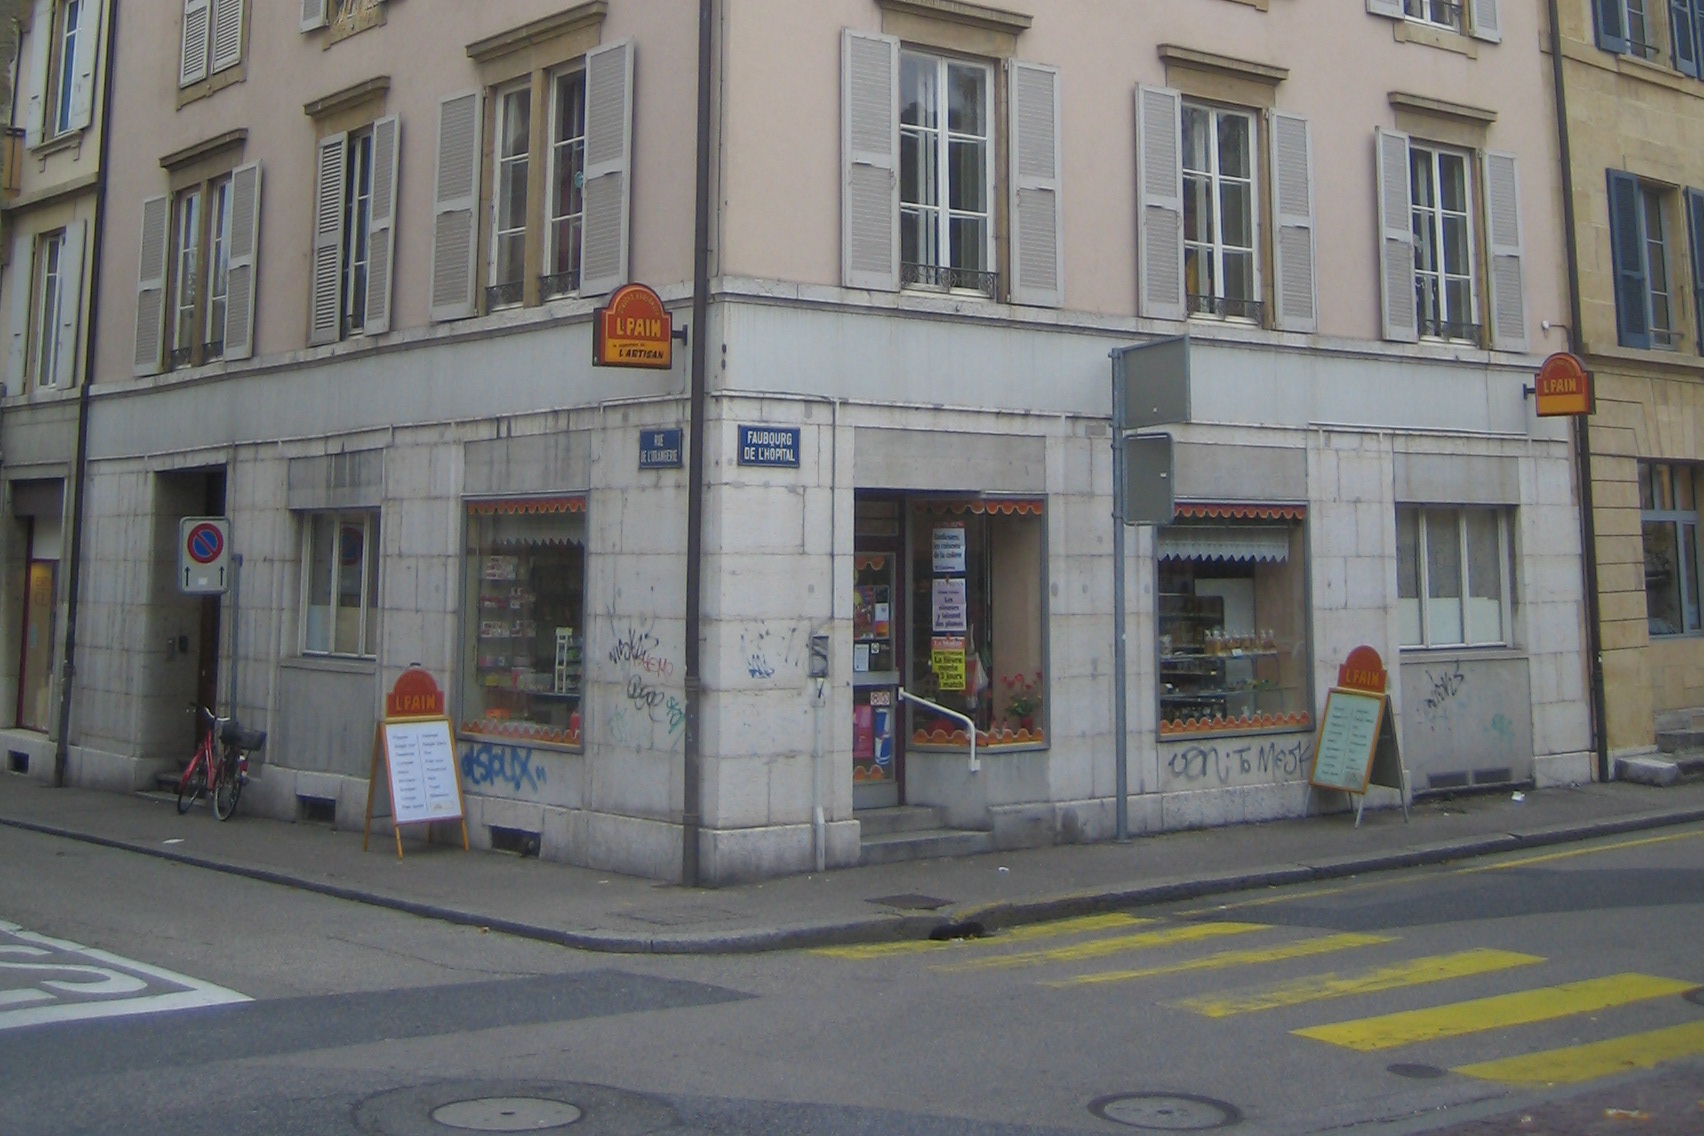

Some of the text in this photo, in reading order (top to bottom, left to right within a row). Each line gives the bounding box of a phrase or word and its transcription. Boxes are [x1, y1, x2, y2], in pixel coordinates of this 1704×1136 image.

[654, 434, 664, 446] RUE
[747, 430, 793, 445] FAUBOURG
[641, 449, 647, 462] DE
[744, 443, 796, 462] DE L'HÔPITAL
